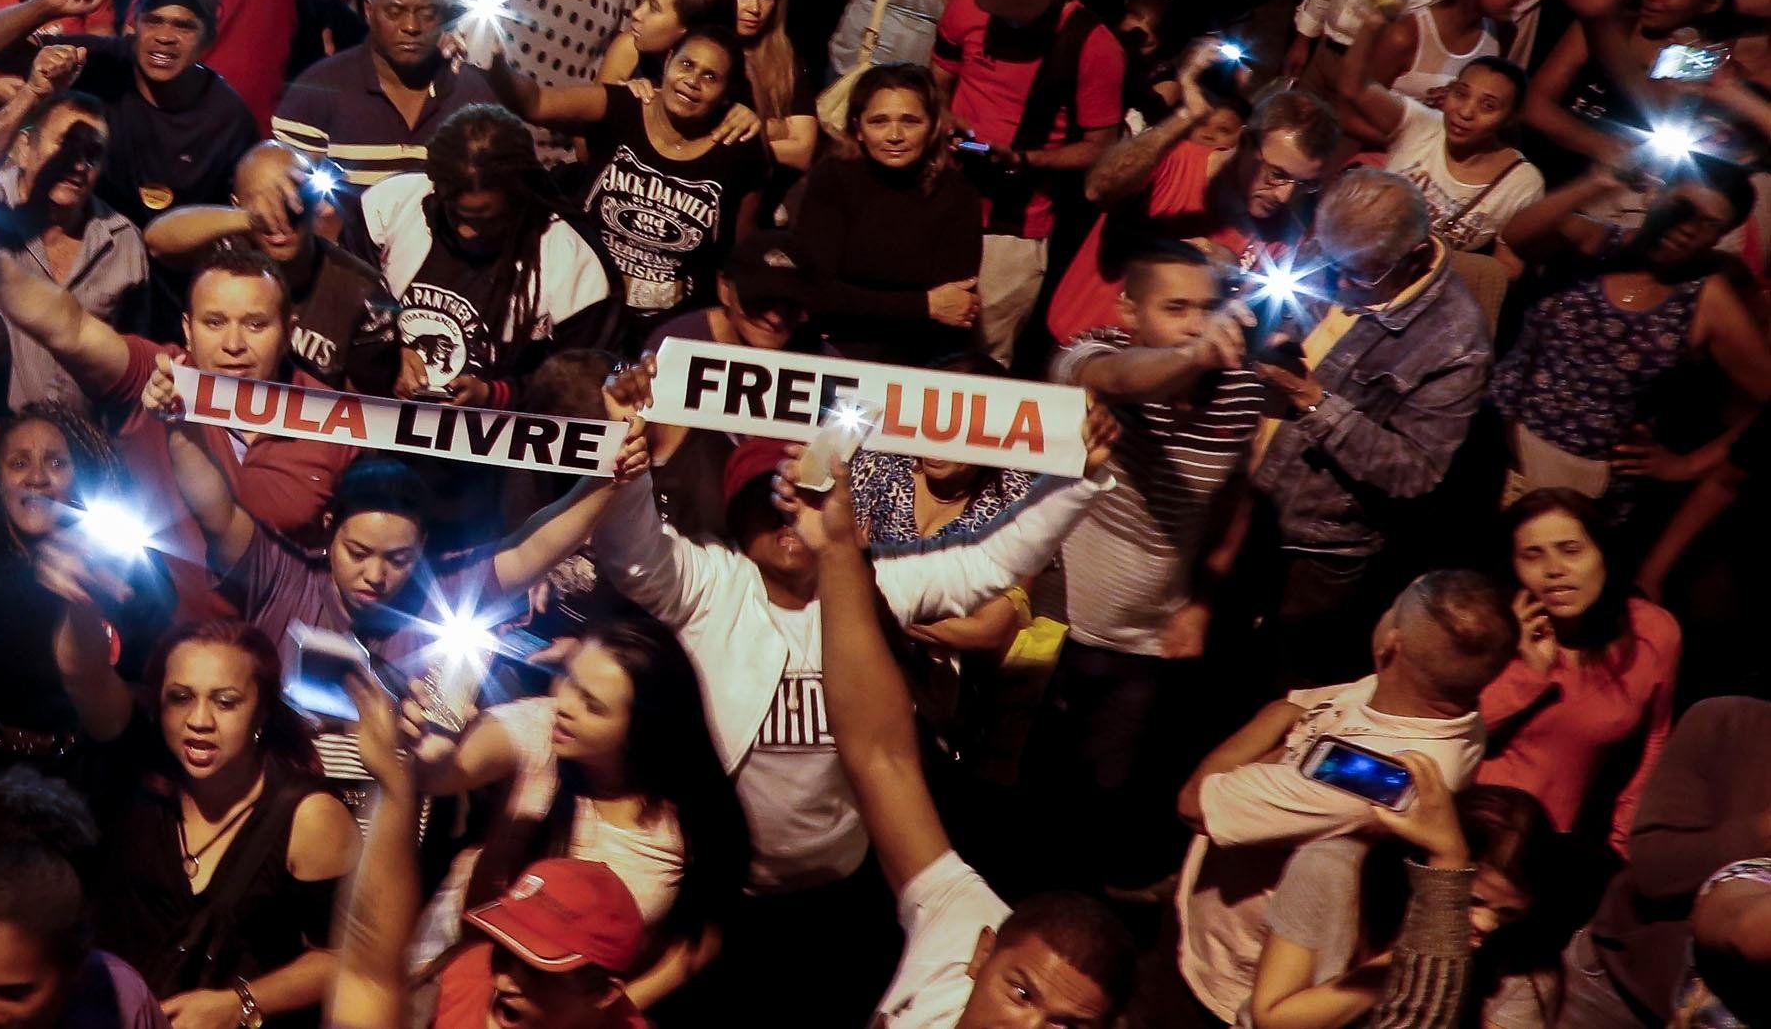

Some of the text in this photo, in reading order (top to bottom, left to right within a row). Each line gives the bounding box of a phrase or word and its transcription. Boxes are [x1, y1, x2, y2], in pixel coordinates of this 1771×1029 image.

[602, 163, 717, 228] JACK DANIEL'S
[193, 374, 607, 471] LULA LIVRE
[881, 382, 1045, 453] LULA
